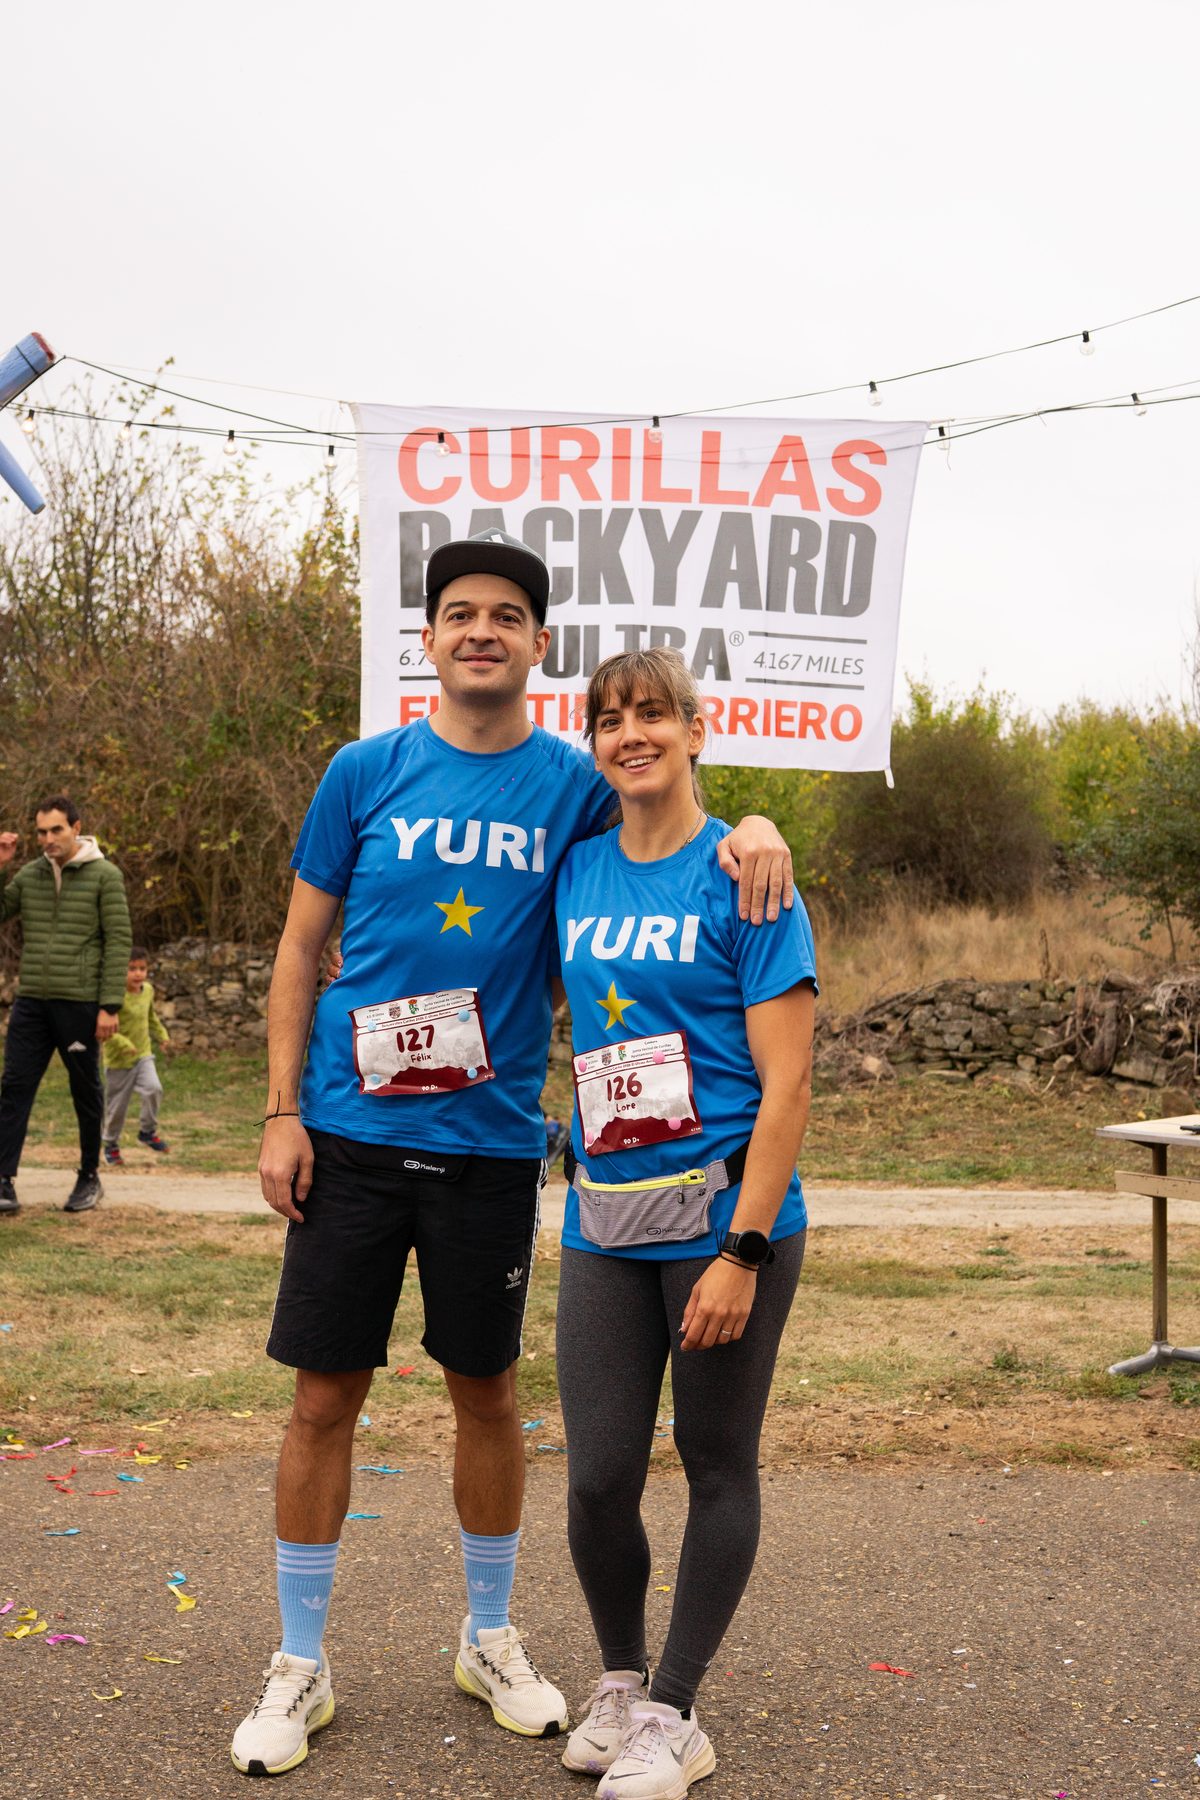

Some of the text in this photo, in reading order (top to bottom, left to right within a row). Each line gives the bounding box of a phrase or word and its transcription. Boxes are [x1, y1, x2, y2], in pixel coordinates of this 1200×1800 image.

[398, 427, 888, 516] CURILLAS
[399, 507, 877, 618] BCKYARD
[753, 651, 865, 676] 4.167 MILES
[701, 695, 863, 742] RRIERO
[390, 817, 548, 873] YURI
[565, 915, 700, 963] YURI
[396, 1024, 435, 1053] 127
[411, 1053, 432, 1063] Félix
[607, 1072, 643, 1102] 126
[616, 1103, 636, 1113] Lore
